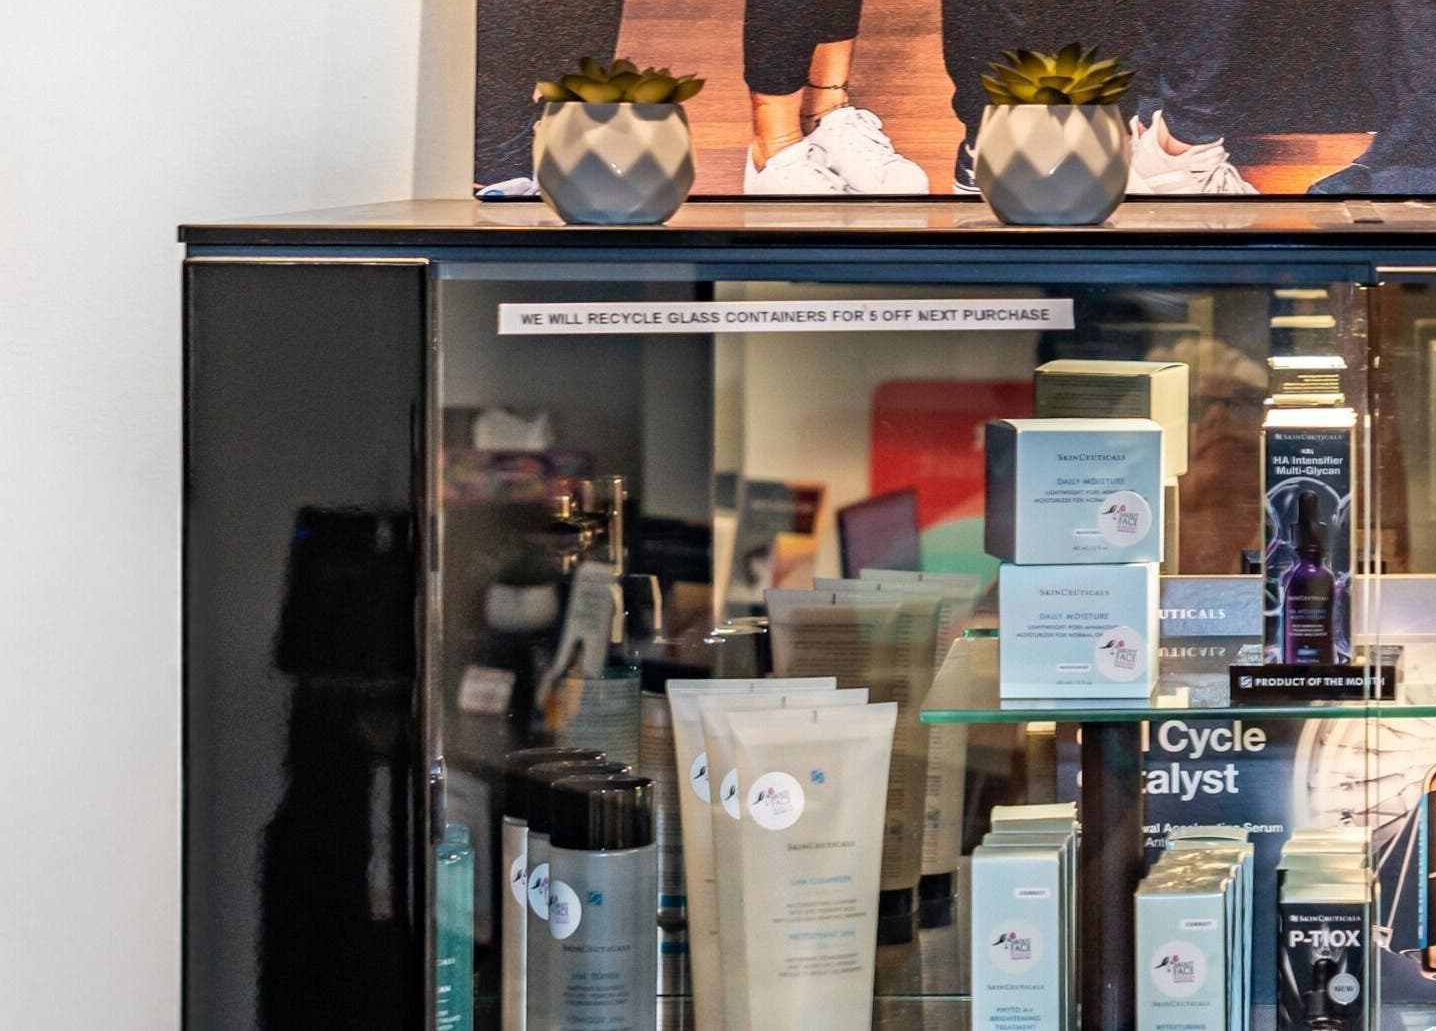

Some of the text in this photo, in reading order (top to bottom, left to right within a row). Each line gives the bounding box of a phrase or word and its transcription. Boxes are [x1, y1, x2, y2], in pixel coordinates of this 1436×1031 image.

[521, 308, 1050, 325] WE WILL RECYCLE GLASS CONTAINERS FOR 5 OFF NEXT PURCHASE
[1273, 456, 1343, 465] HA Intensifier
[1276, 466, 1341, 476] Multi-Glycan
[1082, 477, 1124, 485] MOISTURE
[1066, 612, 1109, 620] MOISTURE
[1159, 609, 1226, 620] UTICALS
[1255, 677, 1305, 687] PRODUCT
[1308, 678, 1322, 686] OF
[1325, 677, 1343, 686] THE
[1158, 720, 1267, 759] Cycle
[1141, 762, 1239, 801] alyst
[1243, 822, 1284, 833] Serum
[1289, 930, 1361, 948] P-TIOX
